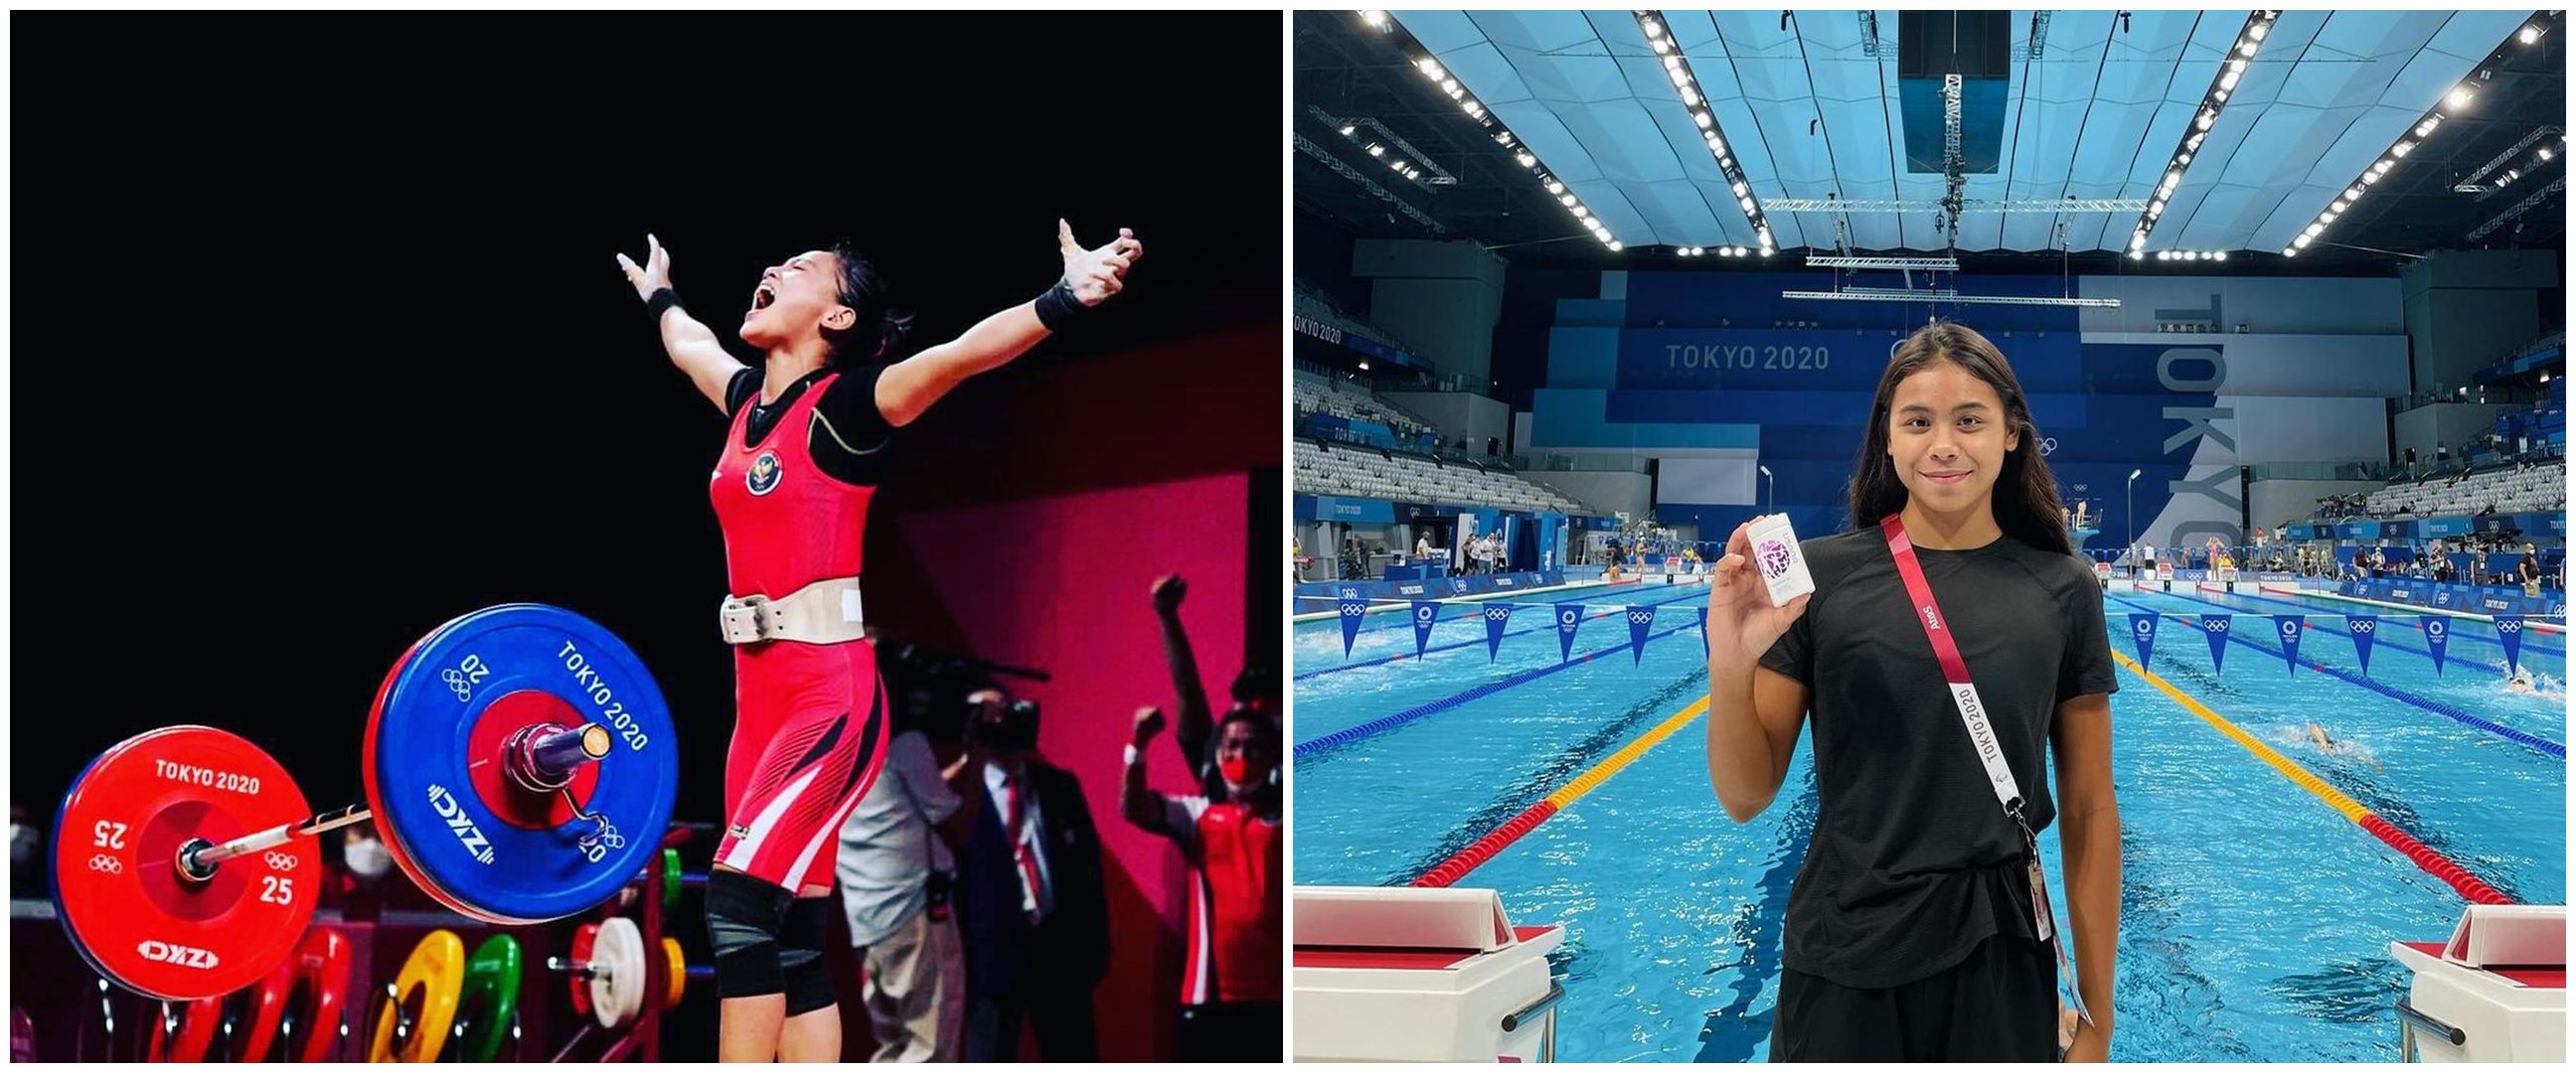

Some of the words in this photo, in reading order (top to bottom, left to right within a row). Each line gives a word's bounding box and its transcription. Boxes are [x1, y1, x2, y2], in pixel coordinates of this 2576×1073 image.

[1294, 314, 1320, 338] OKYO
[1320, 324, 1342, 345] 2020
[1666, 344, 1756, 370] TOKYO
[1763, 346, 1830, 371] 2020
[460, 654, 490, 685] 20
[558, 641, 612, 705] TOKYO
[604, 702, 649, 752] 2020
[1959, 689, 1981, 721] 2020
[1973, 722, 1998, 764] TOKYO
[155, 759, 215, 787] TOKYO
[216, 772, 260, 795] 2020
[93, 820, 128, 850] 25
[431, 793, 492, 860] ZKC
[260, 875, 293, 906] 25
[147, 940, 210, 971] ZKC
